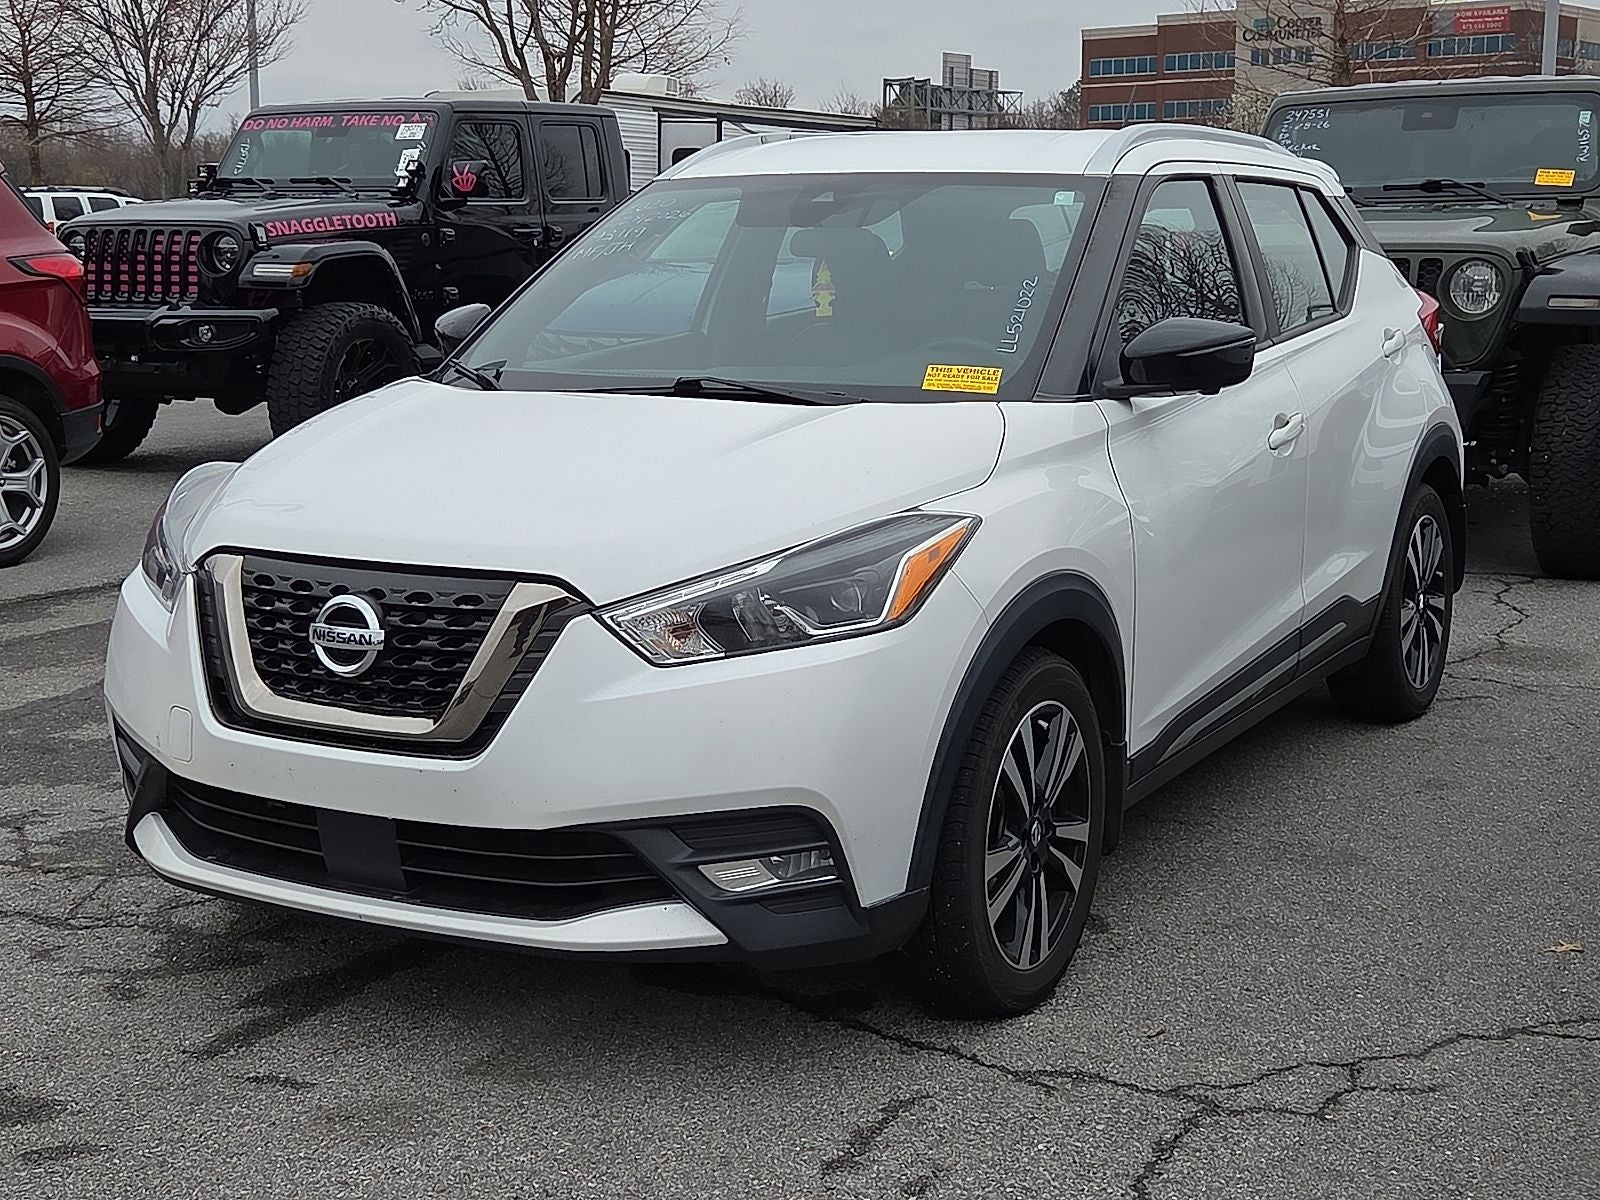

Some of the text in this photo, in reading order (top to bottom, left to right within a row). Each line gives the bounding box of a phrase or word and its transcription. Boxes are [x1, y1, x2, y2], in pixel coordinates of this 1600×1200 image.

[1474, 8, 1509, 16] AVAILABLE
[1277, 16, 1322, 29] COOPER
[242, 119, 265, 131] DO
[265, 118, 288, 129] NO
[341, 115, 380, 126] TAKE
[380, 115, 405, 126] NO
[266, 212, 397, 237] SNAGGLETOOTH
[996, 275, 1039, 353] LL521022
[956, 367, 1000, 376] VEHICLE
[312, 628, 373, 646] NISSAN
